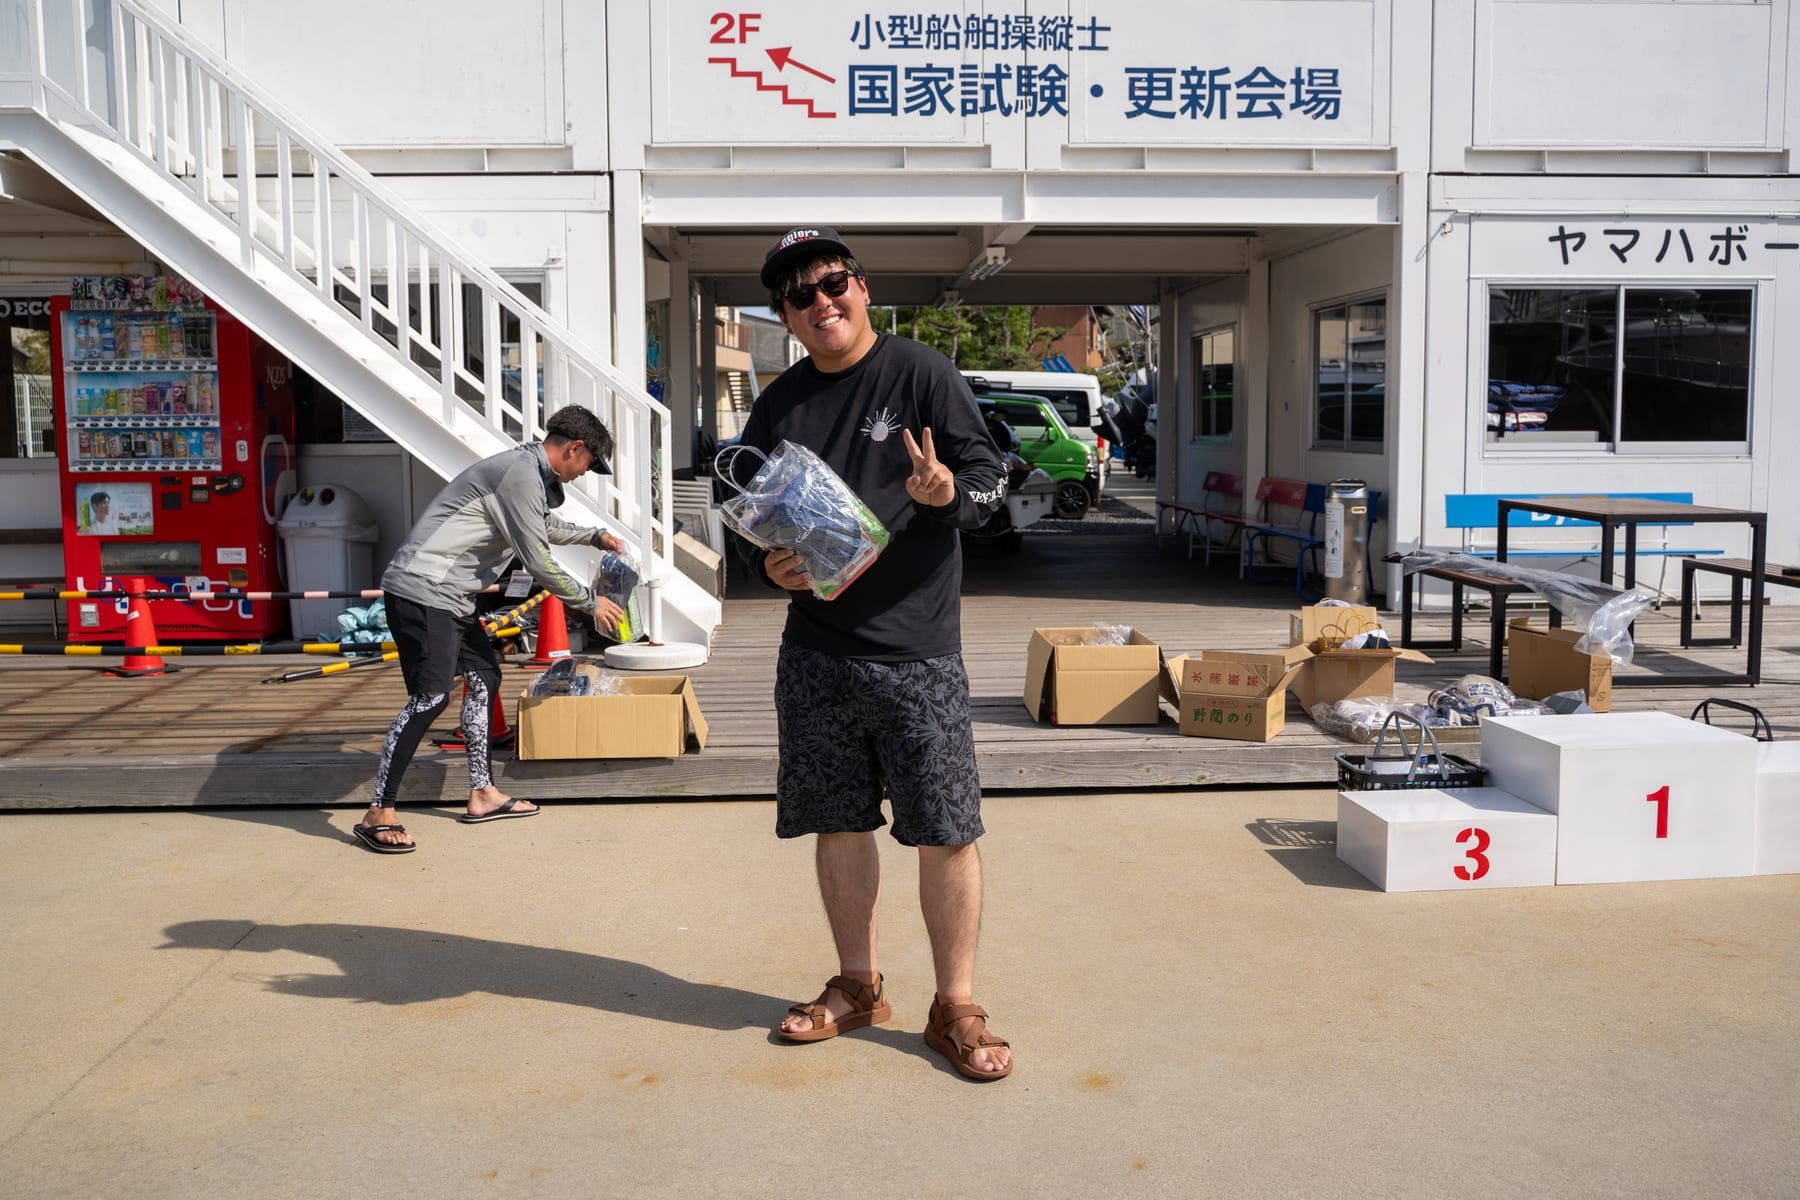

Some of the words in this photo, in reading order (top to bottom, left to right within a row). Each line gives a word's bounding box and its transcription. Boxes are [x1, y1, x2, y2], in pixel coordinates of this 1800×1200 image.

[711, 13, 761, 44] 2F
[851, 14, 1108, 51] 小型船舶操縦士
[848, 64, 1343, 120] 国家試験・更新会場
[1549, 225, 1800, 266] ヤマハボー
[1193, 707, 1253, 727] 野間のり
[1647, 786, 1669, 839] 1
[1453, 828, 1491, 881] 3
